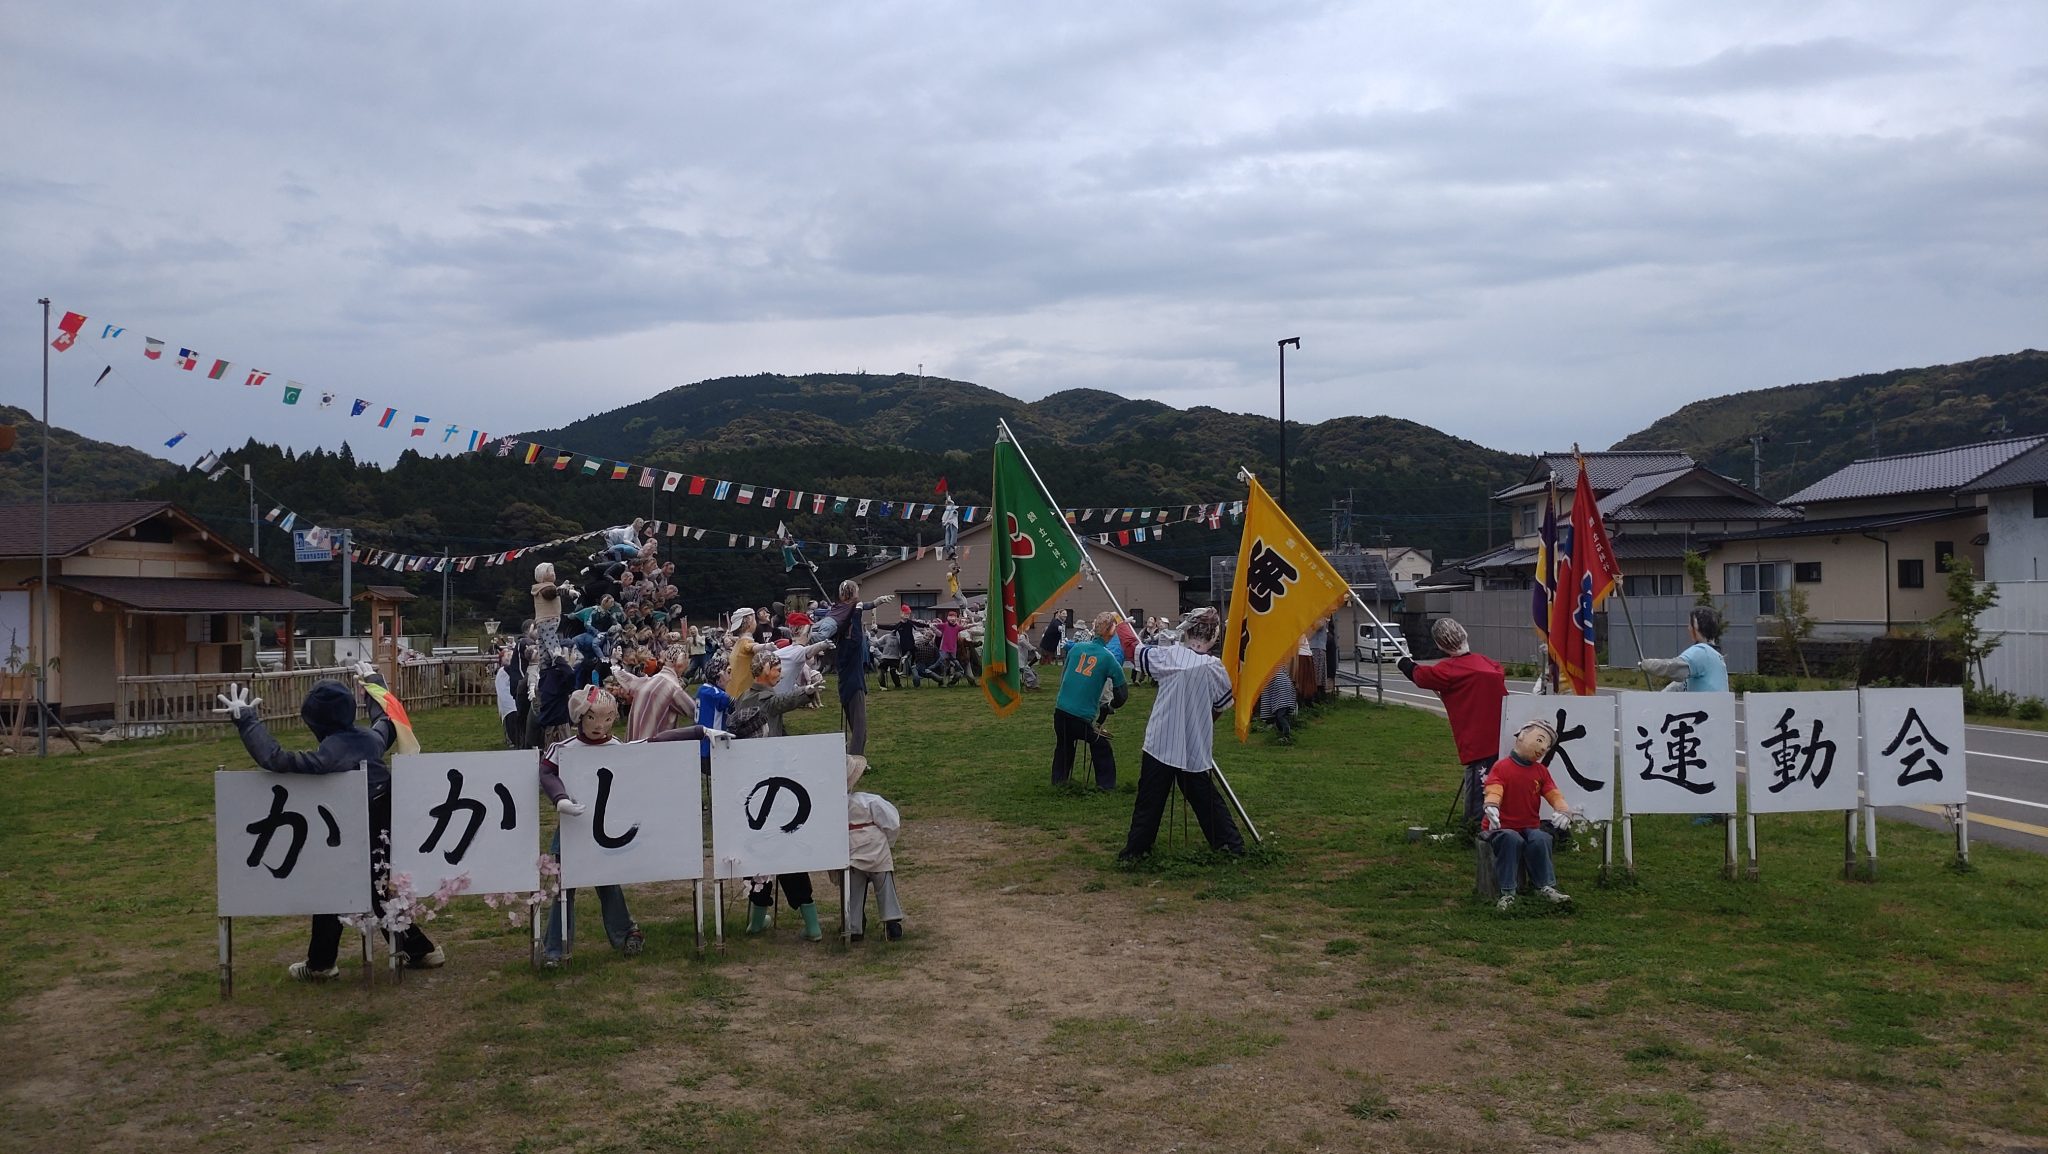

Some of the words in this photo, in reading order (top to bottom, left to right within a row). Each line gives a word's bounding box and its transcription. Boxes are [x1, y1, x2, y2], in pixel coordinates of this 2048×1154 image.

[1075, 652, 1098, 677] 12
[1635, 710, 1717, 795] 運
[1760, 707, 1837, 794] 動
[1881, 708, 1950, 787] 会
[246, 784, 341, 880] か
[419, 768, 517, 866] か
[745, 776, 812, 834] の
